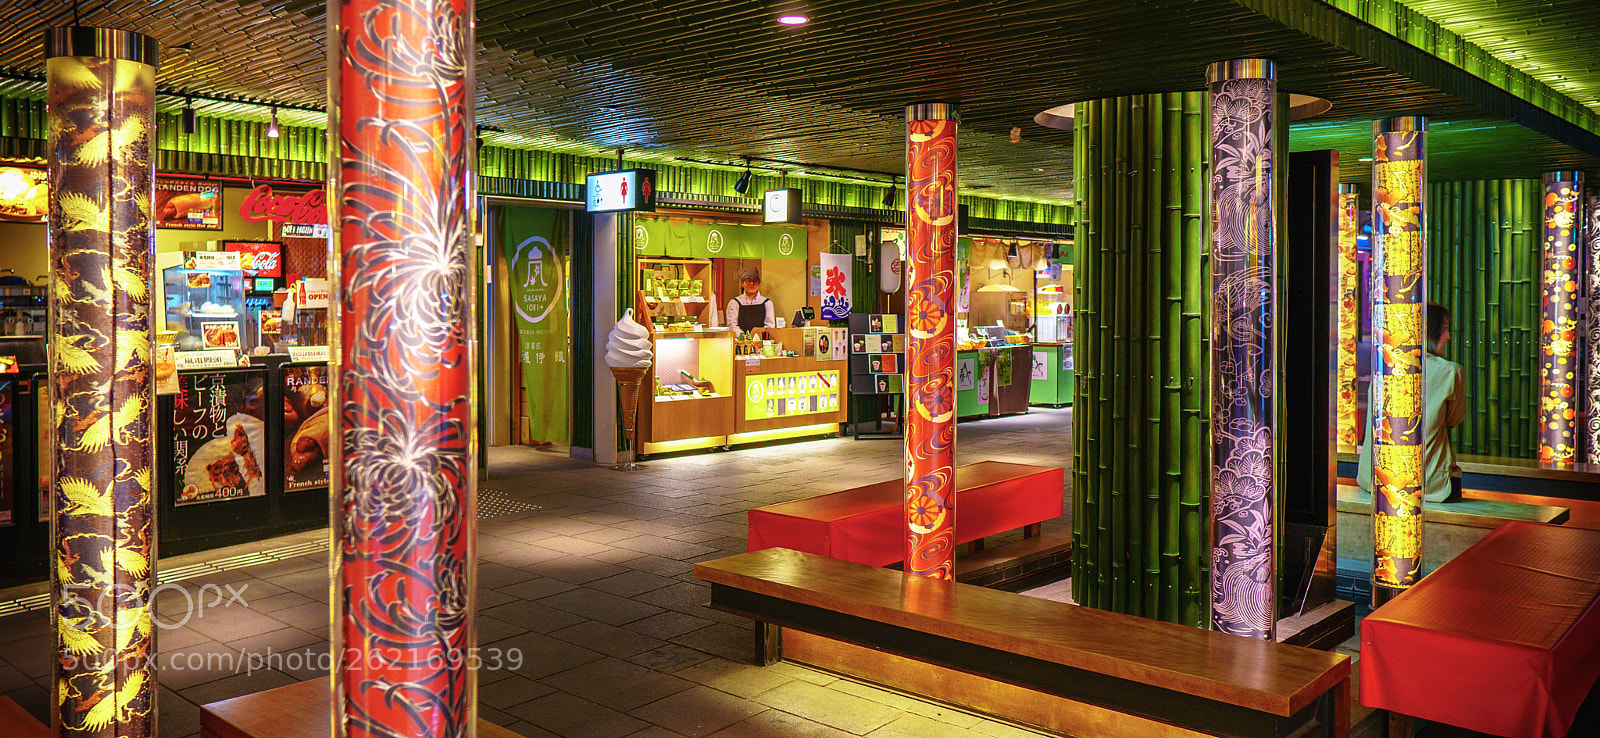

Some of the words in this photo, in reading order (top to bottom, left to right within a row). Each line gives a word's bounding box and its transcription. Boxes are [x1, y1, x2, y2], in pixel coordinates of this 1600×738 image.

[825, 265, 847, 300] 氷
[523, 294, 547, 302] SASAYA
[286, 376, 329, 386] RANDE
[192, 374, 208, 440] ビーフの
[209, 373, 227, 438] 京漬物と
[288, 480, 313, 488] French
